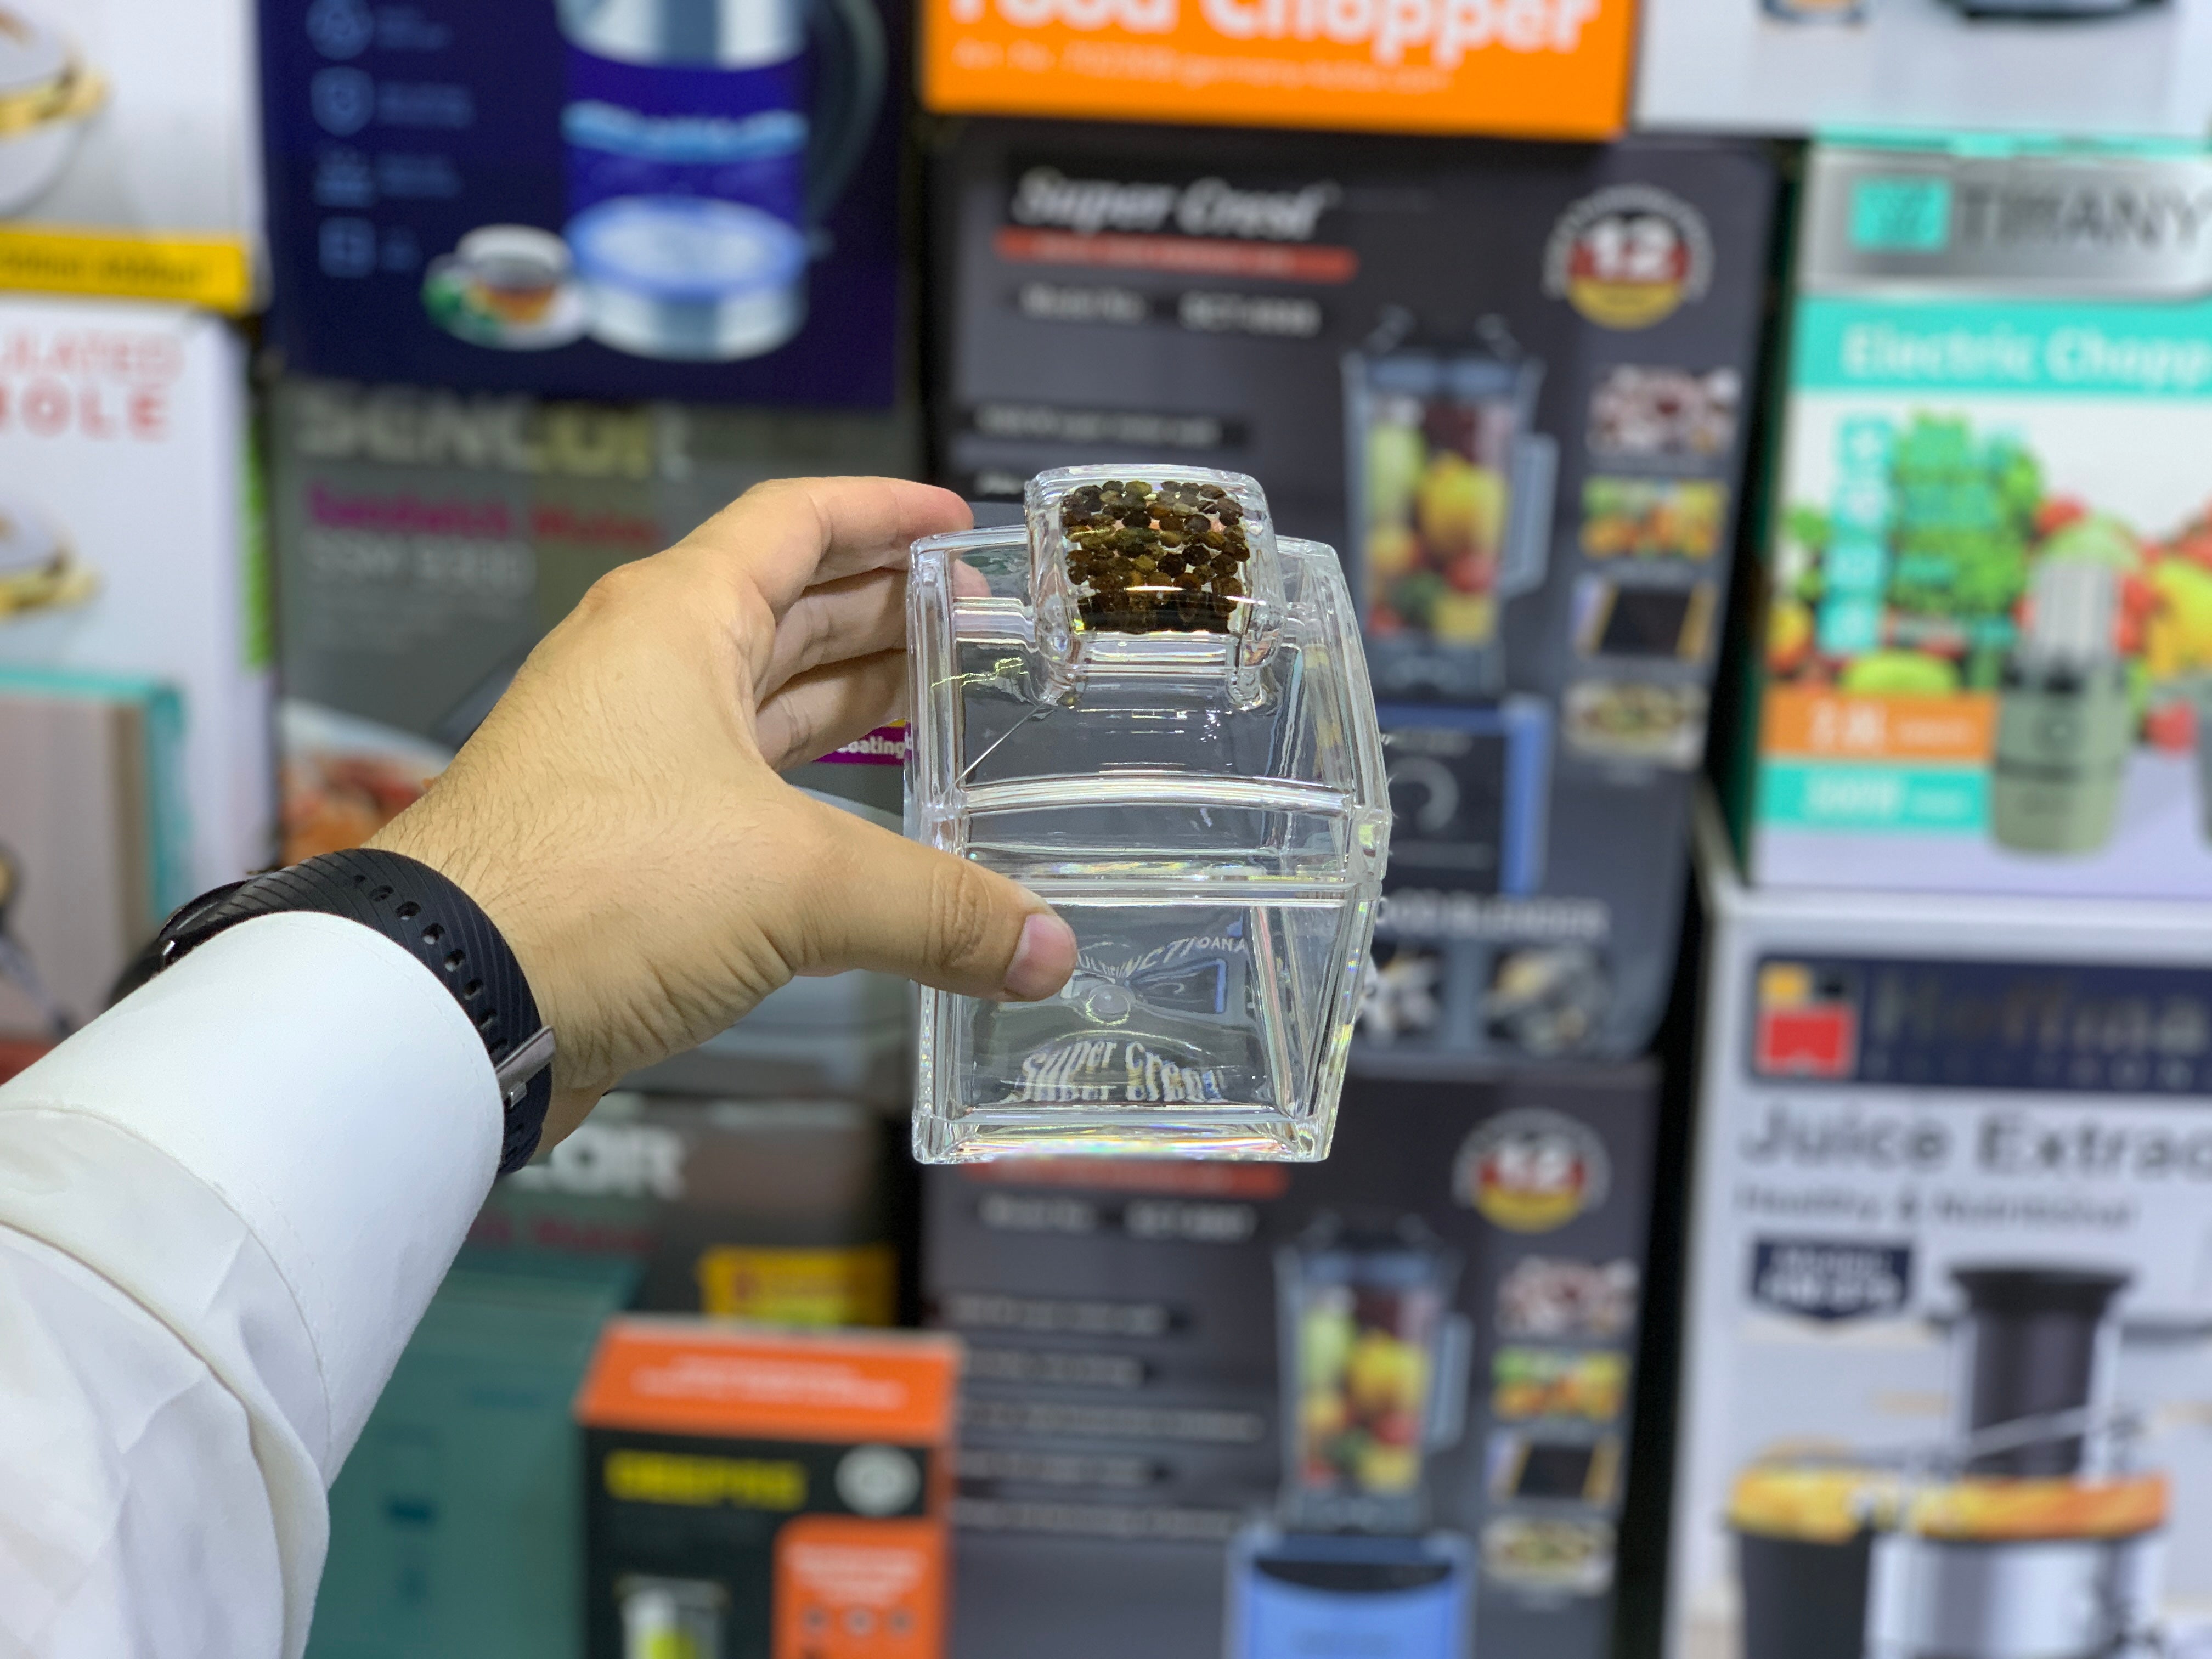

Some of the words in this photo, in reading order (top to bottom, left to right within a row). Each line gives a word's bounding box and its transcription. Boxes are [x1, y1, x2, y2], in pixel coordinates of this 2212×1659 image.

[1012, 166, 1177, 233] Super
[1174, 177, 1323, 240] Crest
[1593, 217, 1674, 281] 12
[1841, 323, 2036, 382] Electric
[836, 735, 905, 760] oating
[1742, 1104, 1950, 1169] Juice
